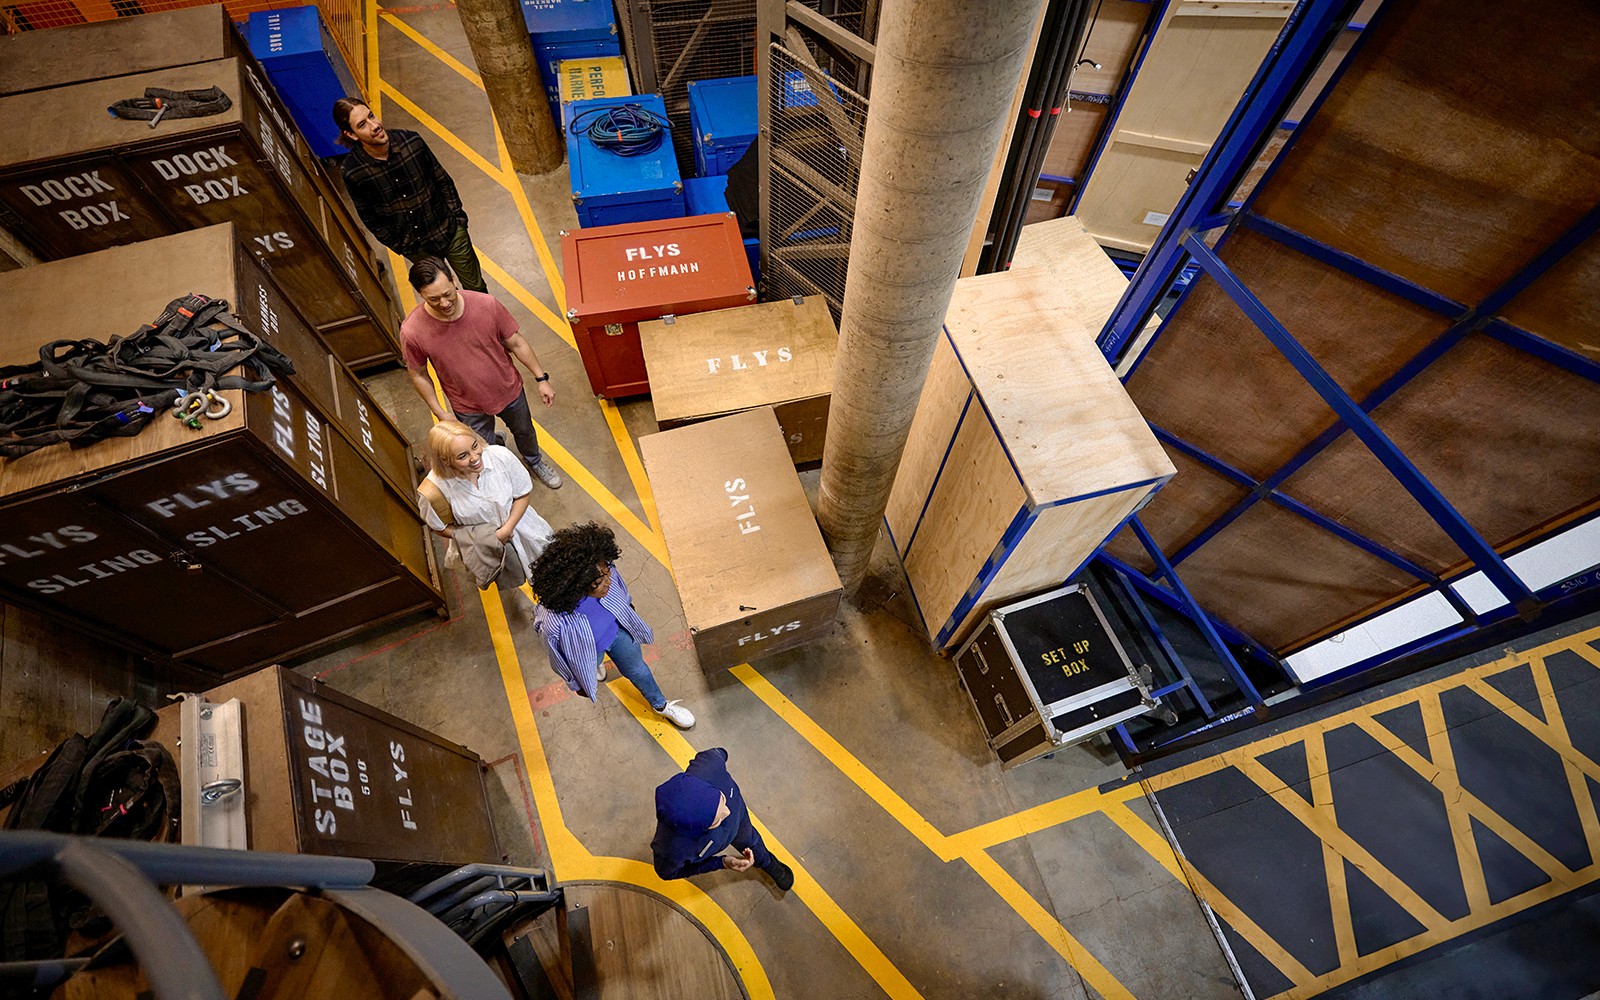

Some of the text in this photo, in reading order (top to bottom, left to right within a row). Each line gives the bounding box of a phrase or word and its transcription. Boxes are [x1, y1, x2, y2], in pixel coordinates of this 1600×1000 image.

[268, 14, 280, 30] TRIP
[568, 67, 585, 100] HARNE
[587, 65, 606, 99] PERFO
[258, 112, 275, 164] DOCK
[151, 145, 238, 181] DOCK
[277, 144, 292, 185] BOX
[19, 170, 115, 207] DOCK
[184, 175, 249, 205] BOX
[58, 200, 130, 230] BOX
[253, 231, 295, 255] YS
[625, 243, 681, 261] FLYS
[617, 262, 700, 282] HOFFMANN
[258, 284, 271, 336] HARNESS
[268, 307, 279, 334] BOX
[706, 346, 793, 374] FLYS
[272, 385, 295, 459] FLYS
[357, 399, 375, 454] FLYS
[305, 409, 327, 491] SLING
[146, 472, 260, 518] FLYS
[724, 477, 760, 535] FLYS
[186, 499, 308, 547] SLING
[27, 549, 163, 594] SLING
[737, 620, 801, 646] FLYS
[1041, 639, 1090, 666] SET UP
[1062, 658, 1090, 678] BOX
[299, 697, 336, 836] STAGE
[327, 732, 354, 811] BOX
[390, 741, 417, 831] FLYS
